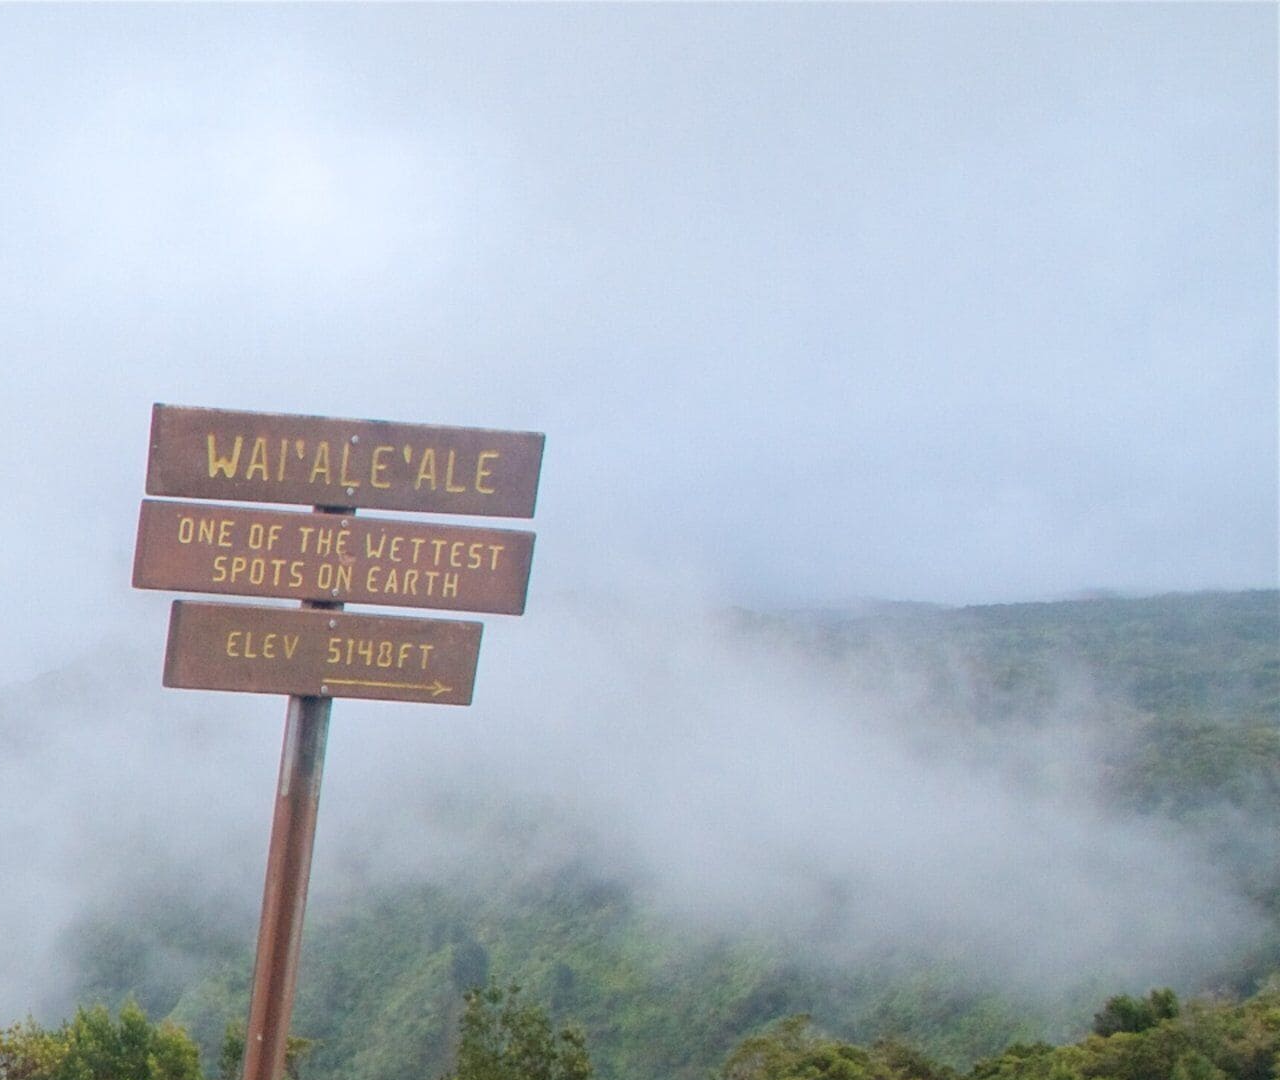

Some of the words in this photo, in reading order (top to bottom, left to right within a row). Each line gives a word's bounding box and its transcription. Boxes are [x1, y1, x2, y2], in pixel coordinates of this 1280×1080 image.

[178, 517, 235, 548] ONE
[249, 524, 282, 551] OF
[300, 527, 351, 555] THE
[366, 533, 504, 571] WETTEST
[212, 556, 305, 588] SPOTS
[318, 563, 352, 591] ON
[366, 566, 459, 598] EARTH
[226, 631, 300, 660] ELEV
